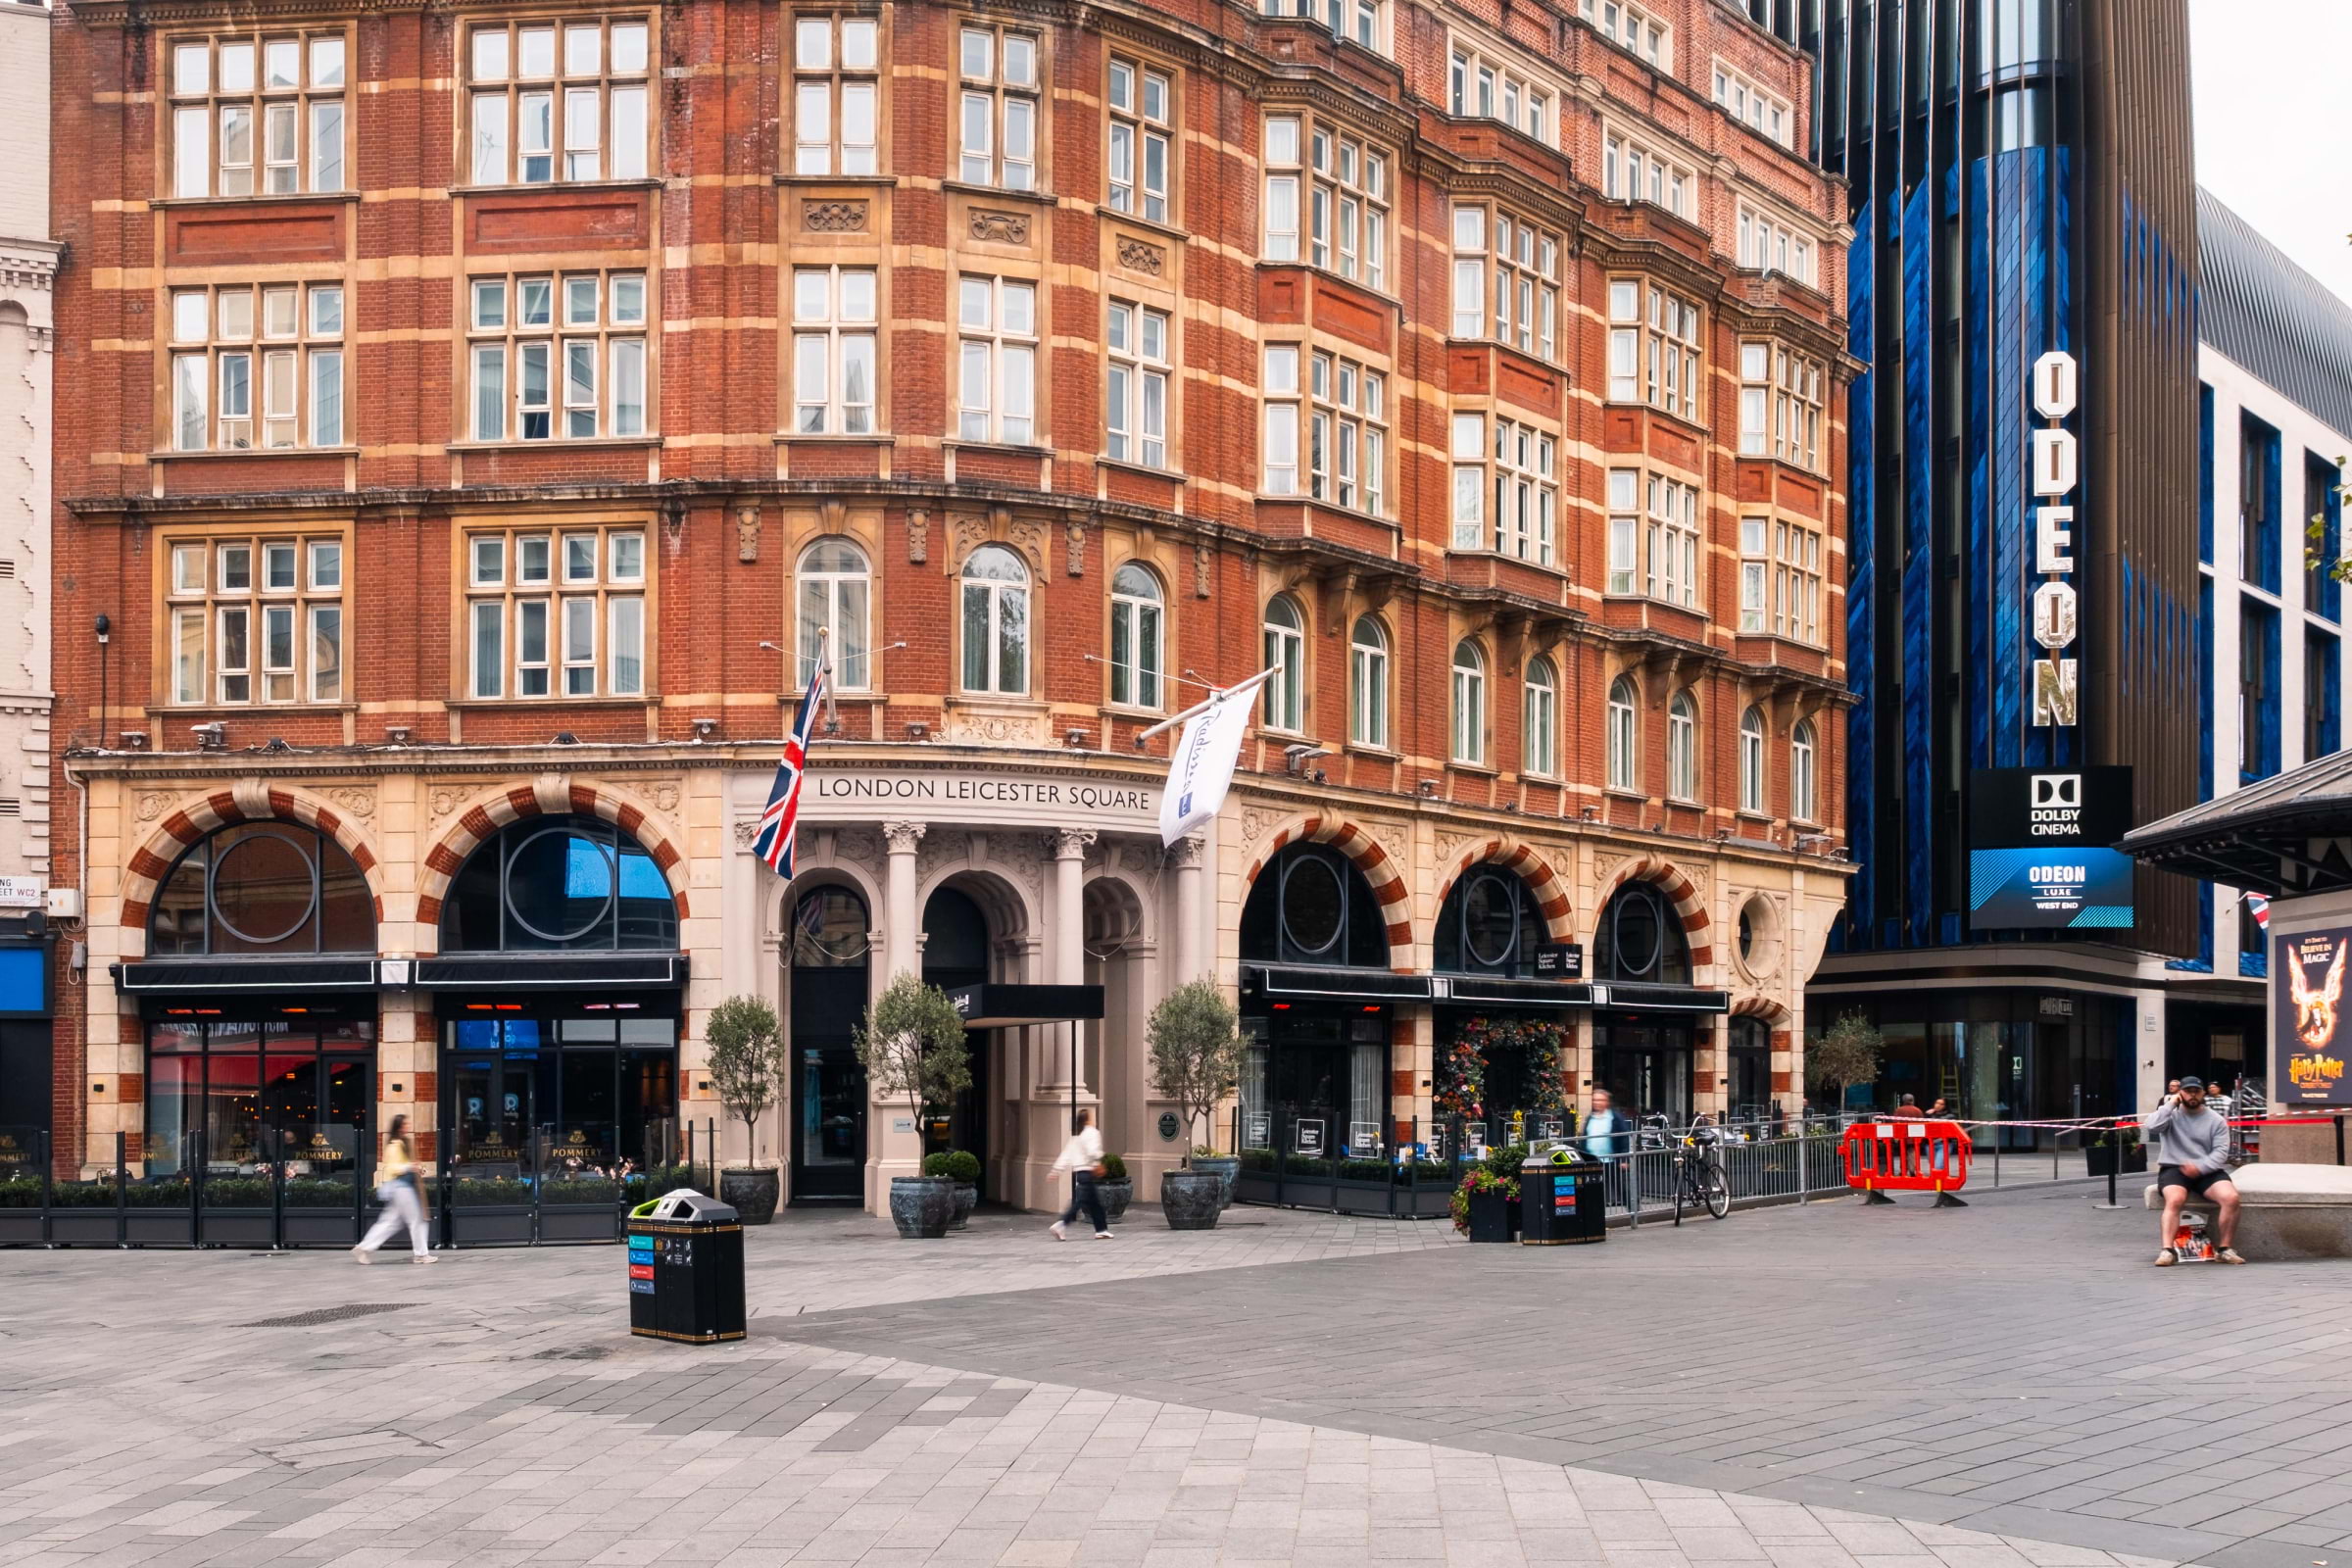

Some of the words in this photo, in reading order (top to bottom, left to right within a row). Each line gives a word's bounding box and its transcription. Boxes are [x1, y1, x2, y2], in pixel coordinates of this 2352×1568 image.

[2034, 351, 2077, 726] ODEON
[819, 778, 934, 798] LONDON
[946, 780, 1060, 804] LEICESTER
[1069, 786, 1150, 809] SQUARE
[2032, 809, 2081, 821] DOLBY
[2032, 823, 2081, 835] CINEMA
[2030, 865, 2085, 882] ODEON
[2303, 953, 2330, 964] MAGIC
[296, 1152, 343, 1160] POMMERY
[468, 1150, 518, 1159] POMMERY
[553, 1148, 602, 1157] POMMERY
